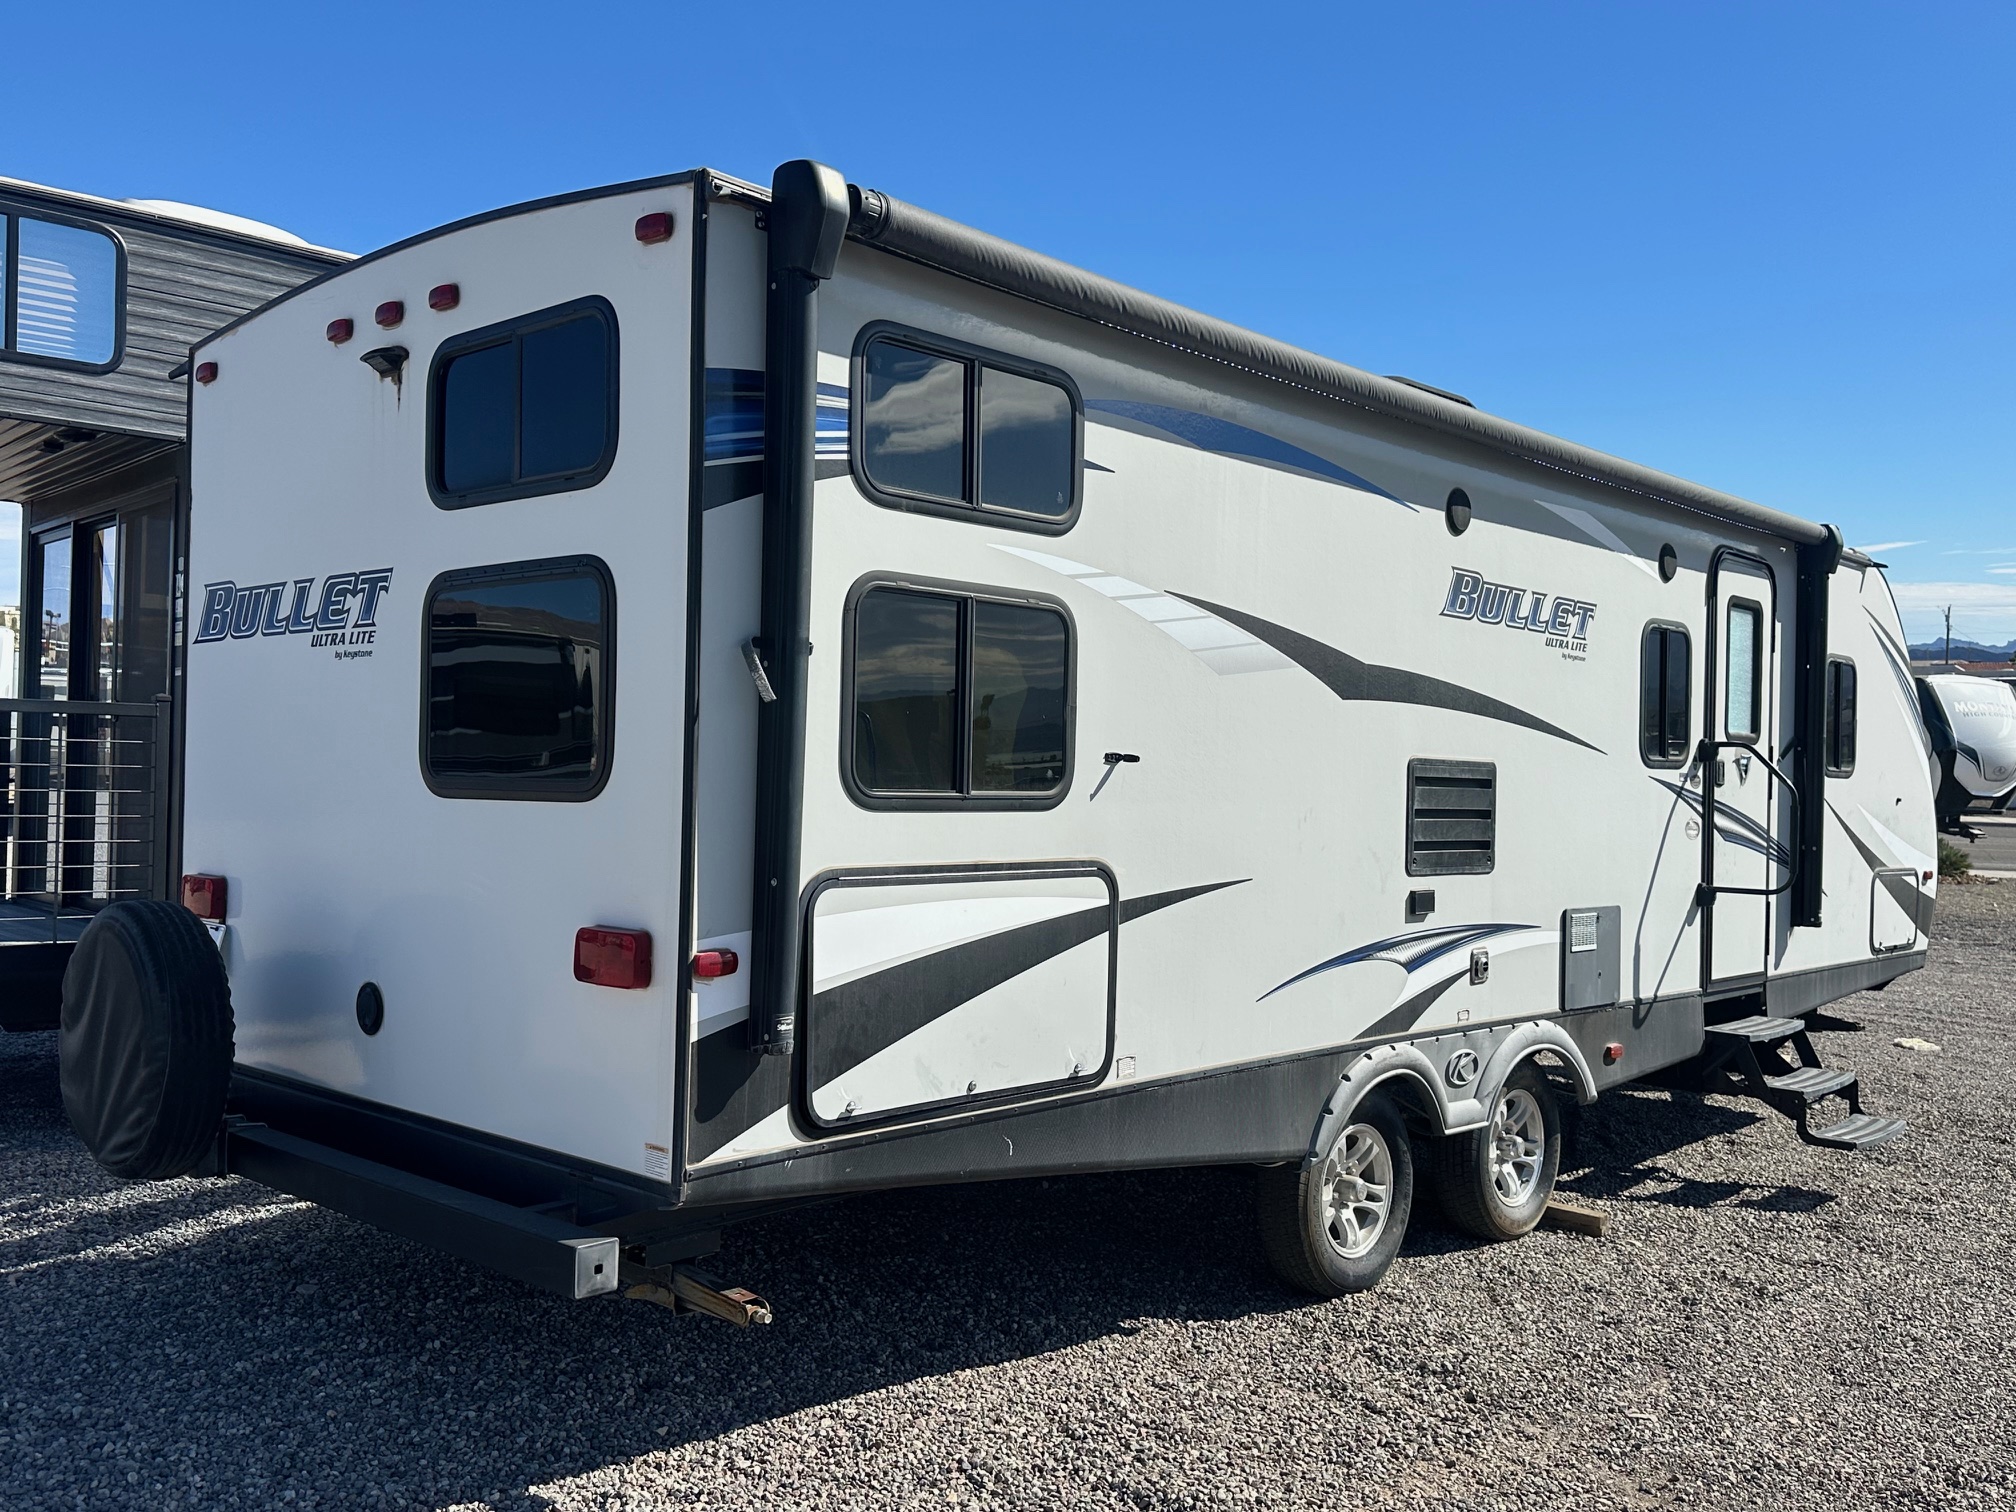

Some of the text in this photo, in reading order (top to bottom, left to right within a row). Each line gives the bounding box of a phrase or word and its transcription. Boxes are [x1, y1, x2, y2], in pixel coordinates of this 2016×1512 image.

[192, 567, 394, 644] BULLET
[1439, 566, 1597, 641] BULLET
[311, 630, 377, 648] ULTRA LITE
[1545, 637, 1588, 652] ULTRA LITE
[334, 649, 373, 660] by Keystone
